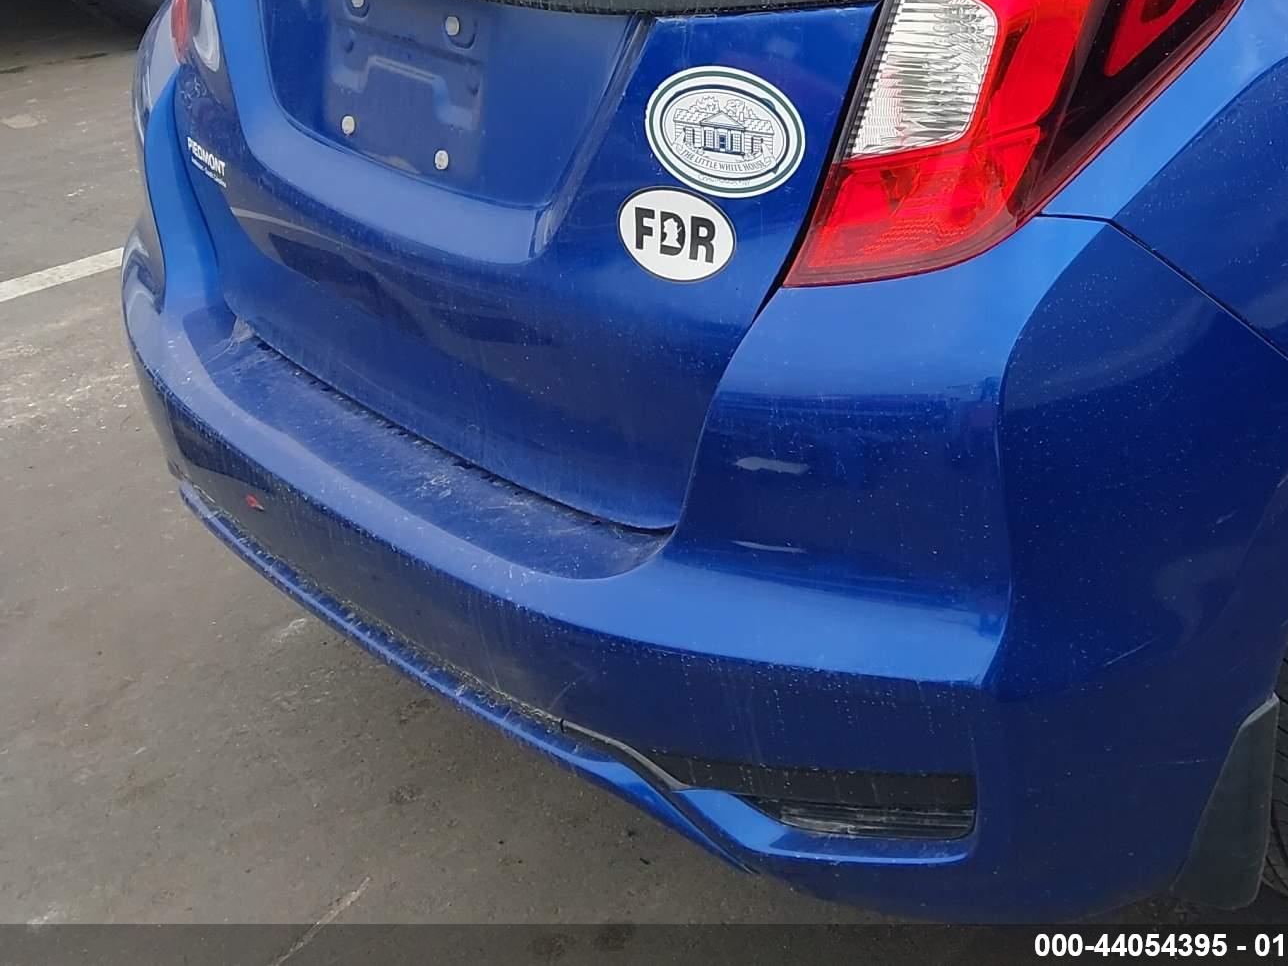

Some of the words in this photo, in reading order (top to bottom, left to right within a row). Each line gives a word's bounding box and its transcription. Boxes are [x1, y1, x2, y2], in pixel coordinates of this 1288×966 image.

[681, 149, 693, 161] THE
[694, 156, 717, 169] LITTLE
[719, 162, 743, 172] WHITE
[743, 160, 766, 172] HOUSE
[634, 206, 716, 264] FDR
